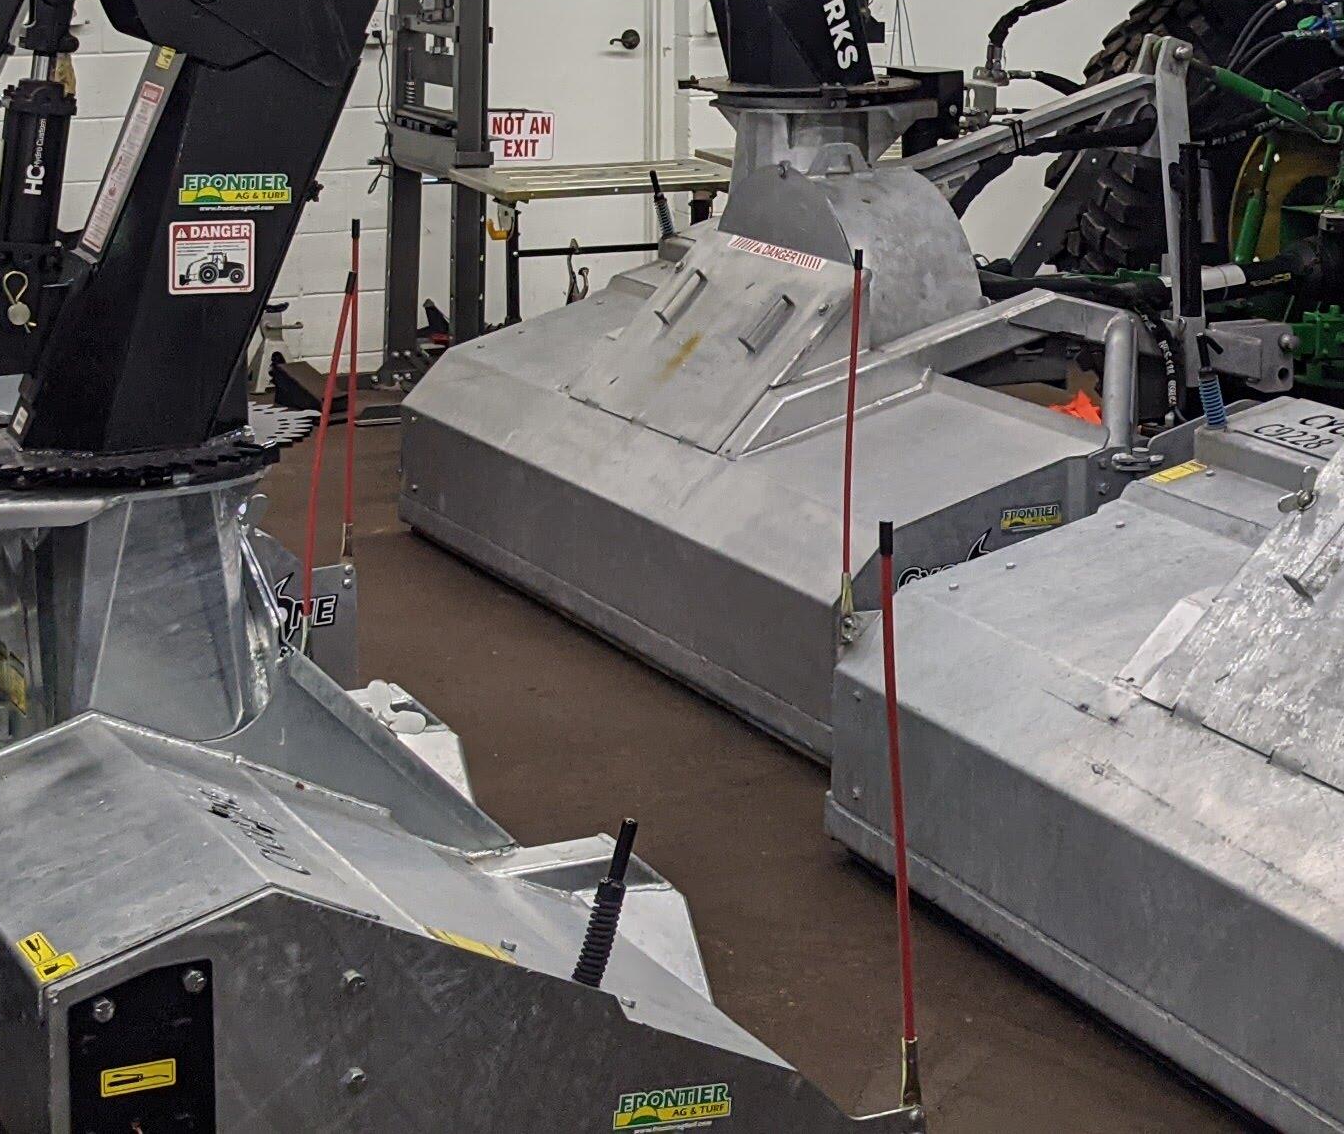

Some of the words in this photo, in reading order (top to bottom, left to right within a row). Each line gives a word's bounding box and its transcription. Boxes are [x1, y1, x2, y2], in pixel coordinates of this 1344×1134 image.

[492, 116, 525, 135] NOT
[529, 116, 551, 135] AN
[503, 139, 539, 157] EXIT
[184, 174, 289, 190] FRONTIER
[235, 192, 250, 200] AG
[261, 191, 286, 199] TURF
[190, 225, 250, 239] DANGER
[762, 244, 798, 262] DANGER
[619, 1084, 730, 1114] FRONTIER
[672, 1109, 687, 1117] AG
[700, 1104, 725, 1114] TURF
